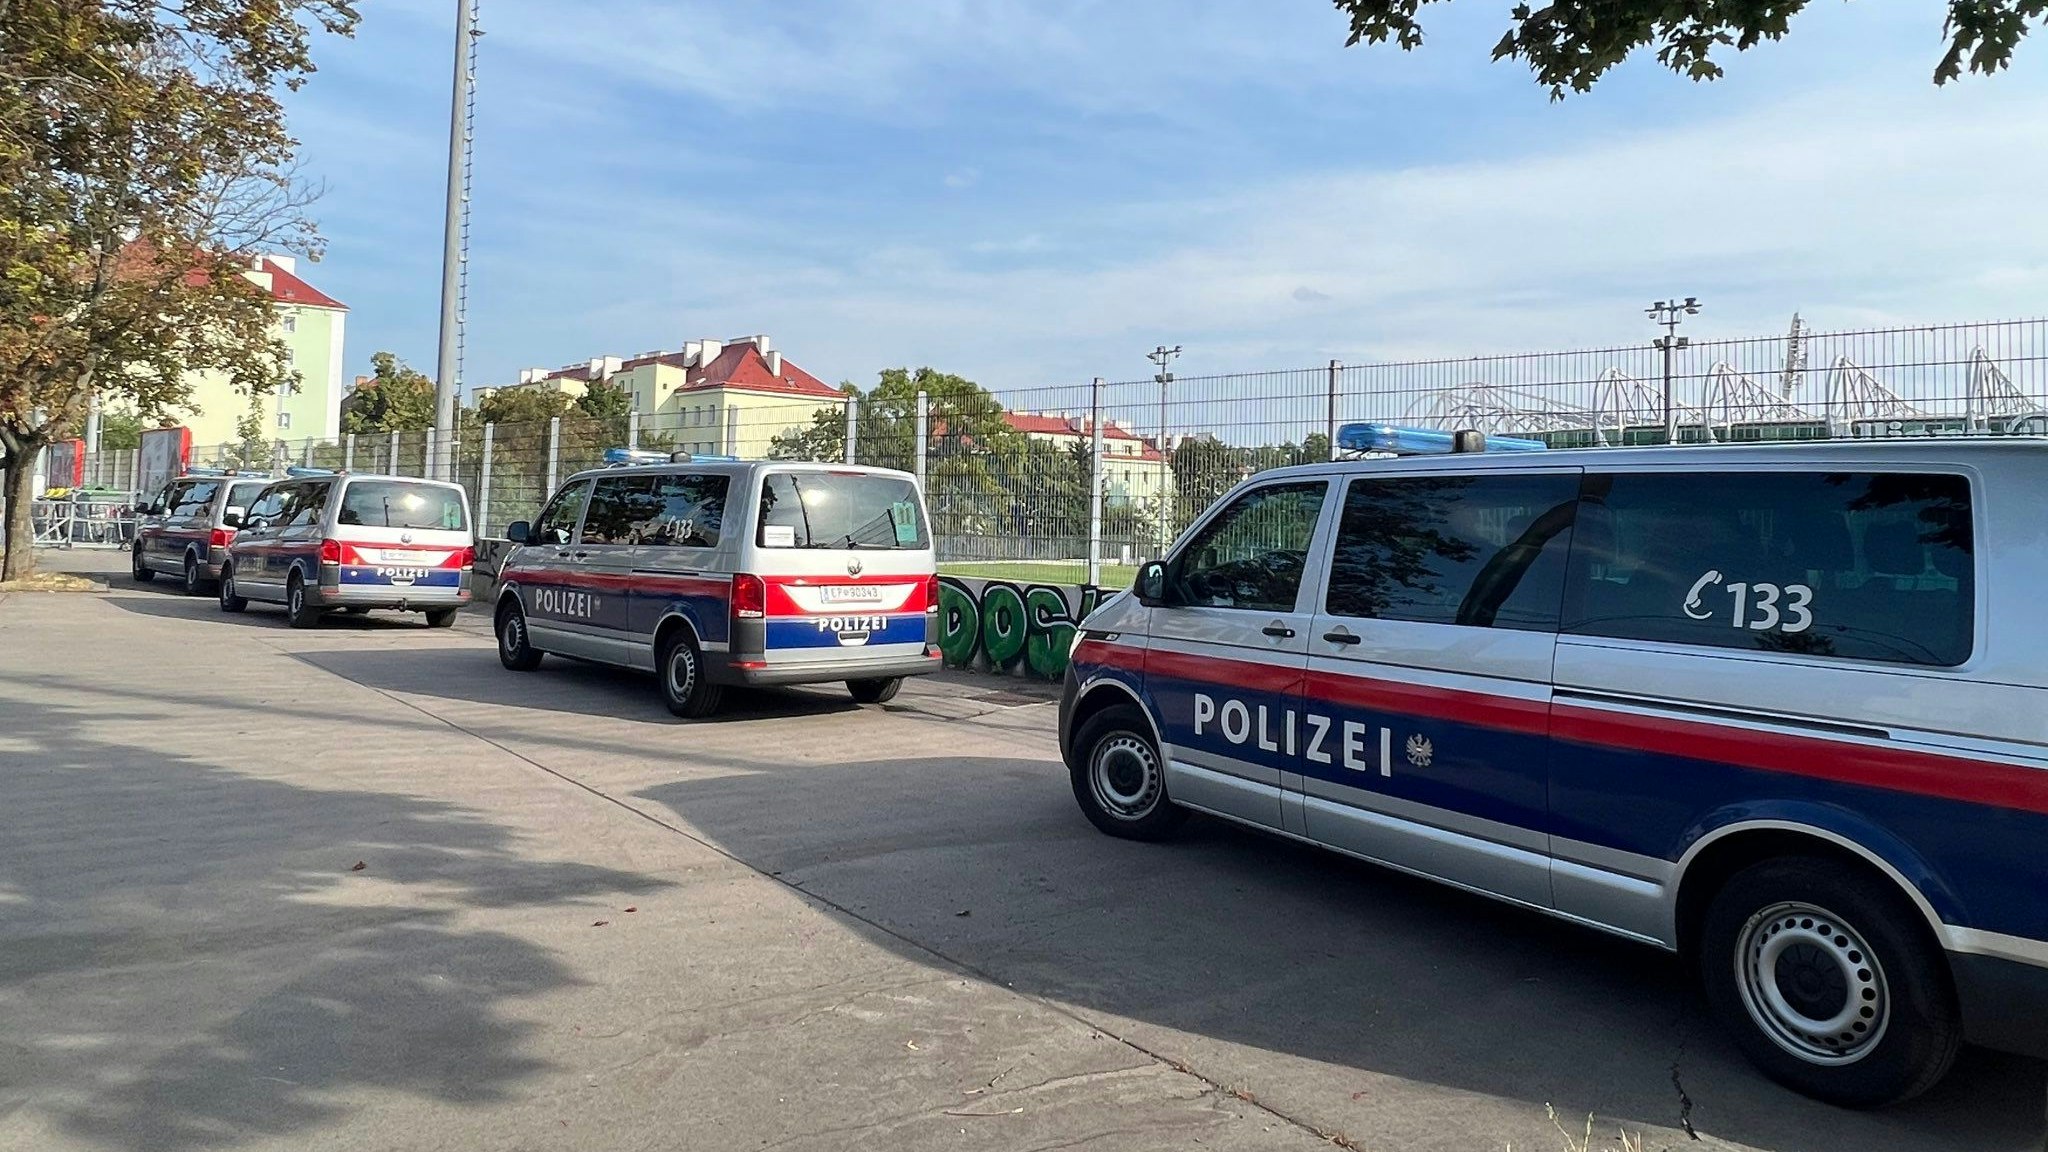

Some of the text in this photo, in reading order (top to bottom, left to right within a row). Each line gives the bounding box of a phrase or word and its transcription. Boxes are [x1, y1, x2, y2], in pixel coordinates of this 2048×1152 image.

[674, 518, 693, 539] 133
[376, 567, 430, 578] POLIZEI
[535, 588, 592, 618] POLIZEI
[1726, 582, 1813, 632] 133
[818, 616, 887, 632] POLIZEI
[1194, 693, 1392, 777] POLIZEI
